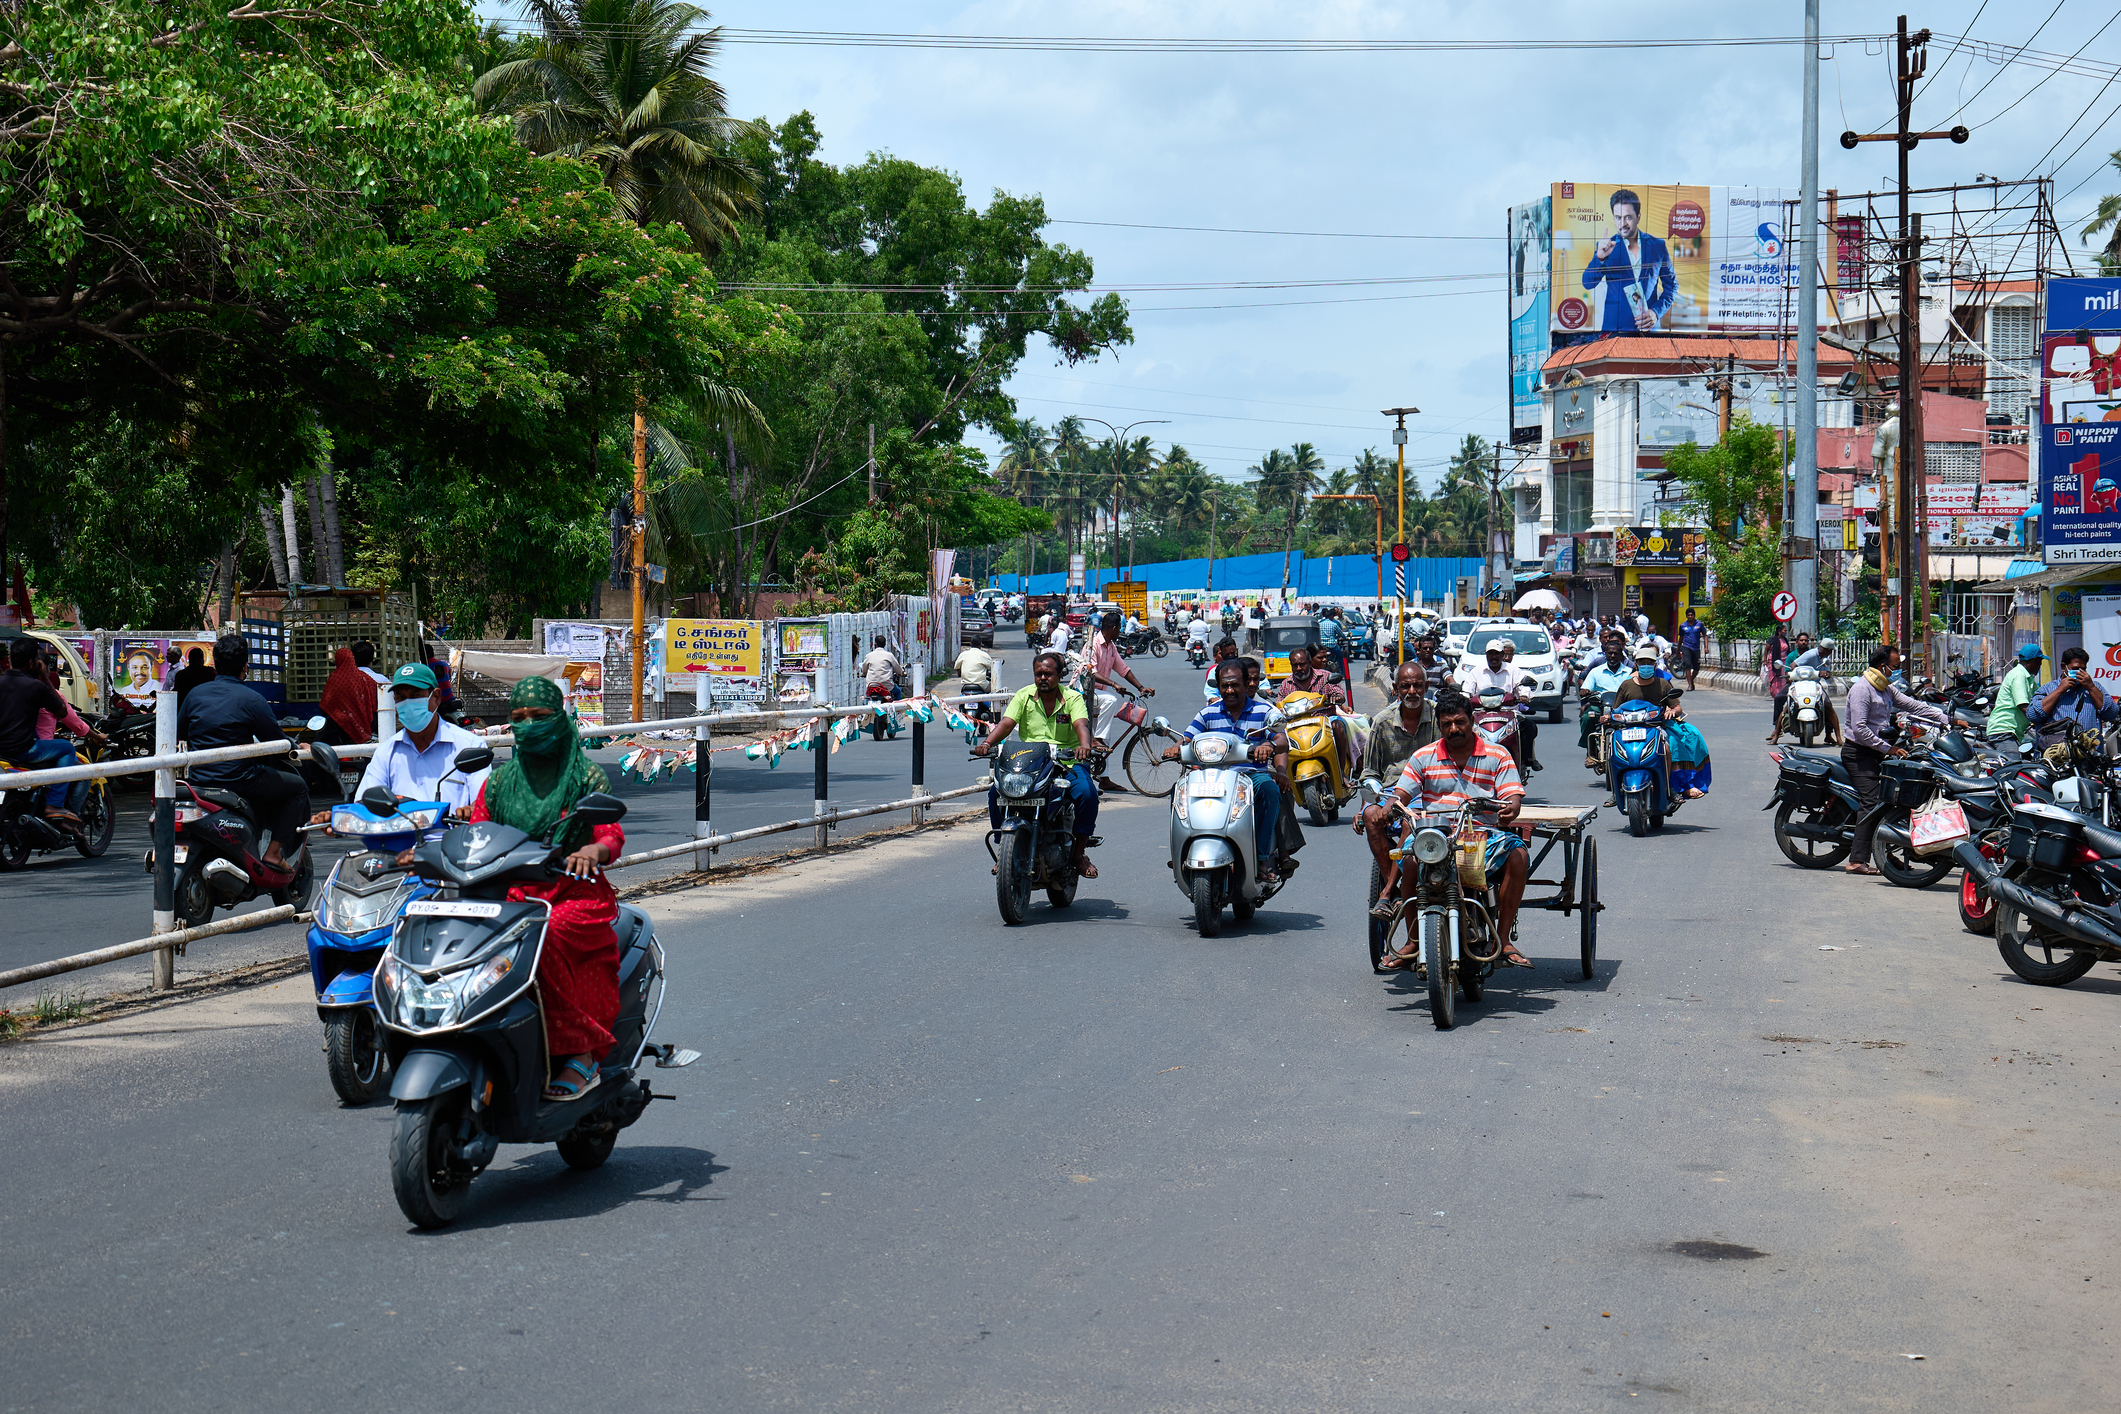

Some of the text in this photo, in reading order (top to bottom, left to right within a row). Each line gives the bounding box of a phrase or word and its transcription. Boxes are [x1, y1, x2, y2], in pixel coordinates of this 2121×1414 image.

[1562, 184, 1573, 193] 37
[1720, 275, 1757, 285] SUDHA
[2084, 290, 2121, 311] mil
[1732, 310, 1767, 318] Helpline:
[1518, 323, 1535, 335] EVENT
[2075, 427, 2119, 436] NIPPON
[2080, 435, 2114, 444] PAINT
[2053, 474, 2078, 483] ASIA'S
[2053, 482, 2079, 491] REAL
[2053, 492, 2080, 507] No.
[2053, 506, 2080, 515] PAINT
[1820, 519, 1842, 528] XEROX
[2052, 521, 2121, 531] International quality
[2090, 530, 2112, 539] paints
[2053, 549, 2077, 560] Shri
[676, 626, 748, 638] G.சங்கர்
[674, 638, 751, 651] டீ ஸ்டால்
[686, 651, 739, 662] எதிரே உள்ளது
[218, 819, 244, 829] Pleasure
[472, 905, 496, 915] 0781
